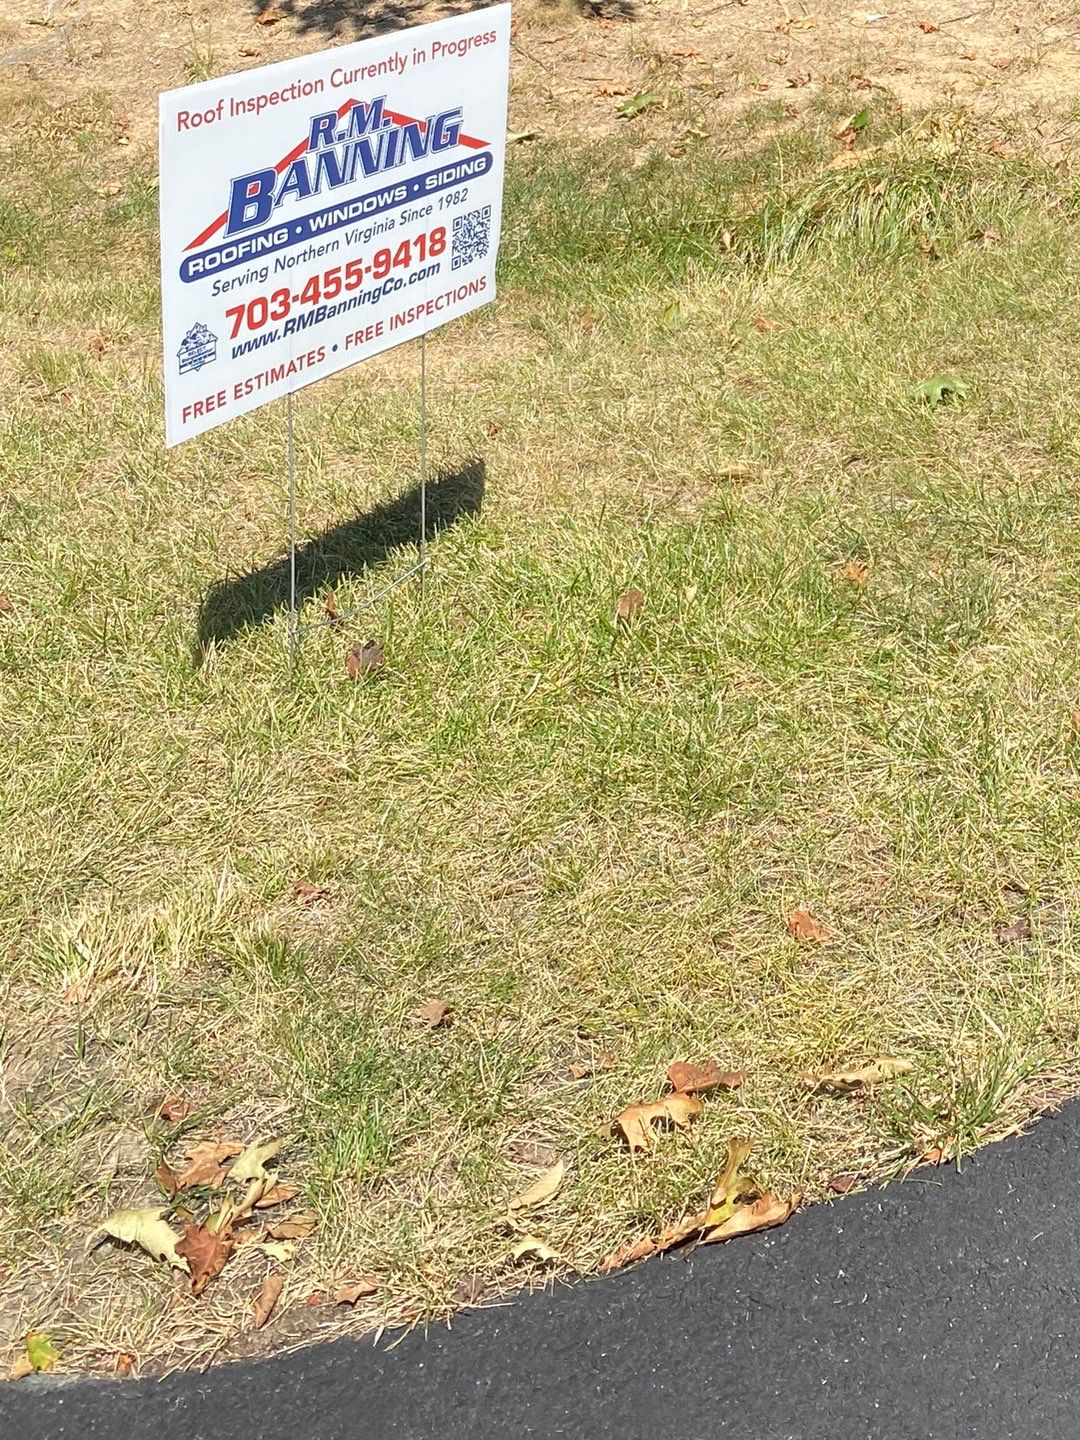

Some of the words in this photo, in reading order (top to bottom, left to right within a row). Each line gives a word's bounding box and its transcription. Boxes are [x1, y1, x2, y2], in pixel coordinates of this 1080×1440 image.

[177, 99, 224, 132] Roof
[230, 79, 324, 116] Inspection
[330, 52, 408, 88] Currently
[413, 48, 426, 65] in
[431, 30, 497, 60] Progress
[308, 95, 392, 151] R.M.
[188, 228, 289, 277] ROOFING
[309, 185, 407, 232] WINDOWS
[425, 157, 487, 190] SIDING
[223, 106, 463, 239] BANNING
[211, 265, 269, 297] Serving
[274, 239, 339, 273] Northern
[344, 217, 395, 246] Virginia
[399, 204, 433, 226] Since
[438, 187, 469, 211] 1982
[225, 226, 447, 340] 703-455-9418
[182, 390, 227, 424] FREE
[234, 346, 326, 401] ESTIMATES
[345, 321, 384, 350] FREE
[389, 276, 487, 331] INSPECTIONS
[232, 262, 441, 359] www.RMBanningCo.com
